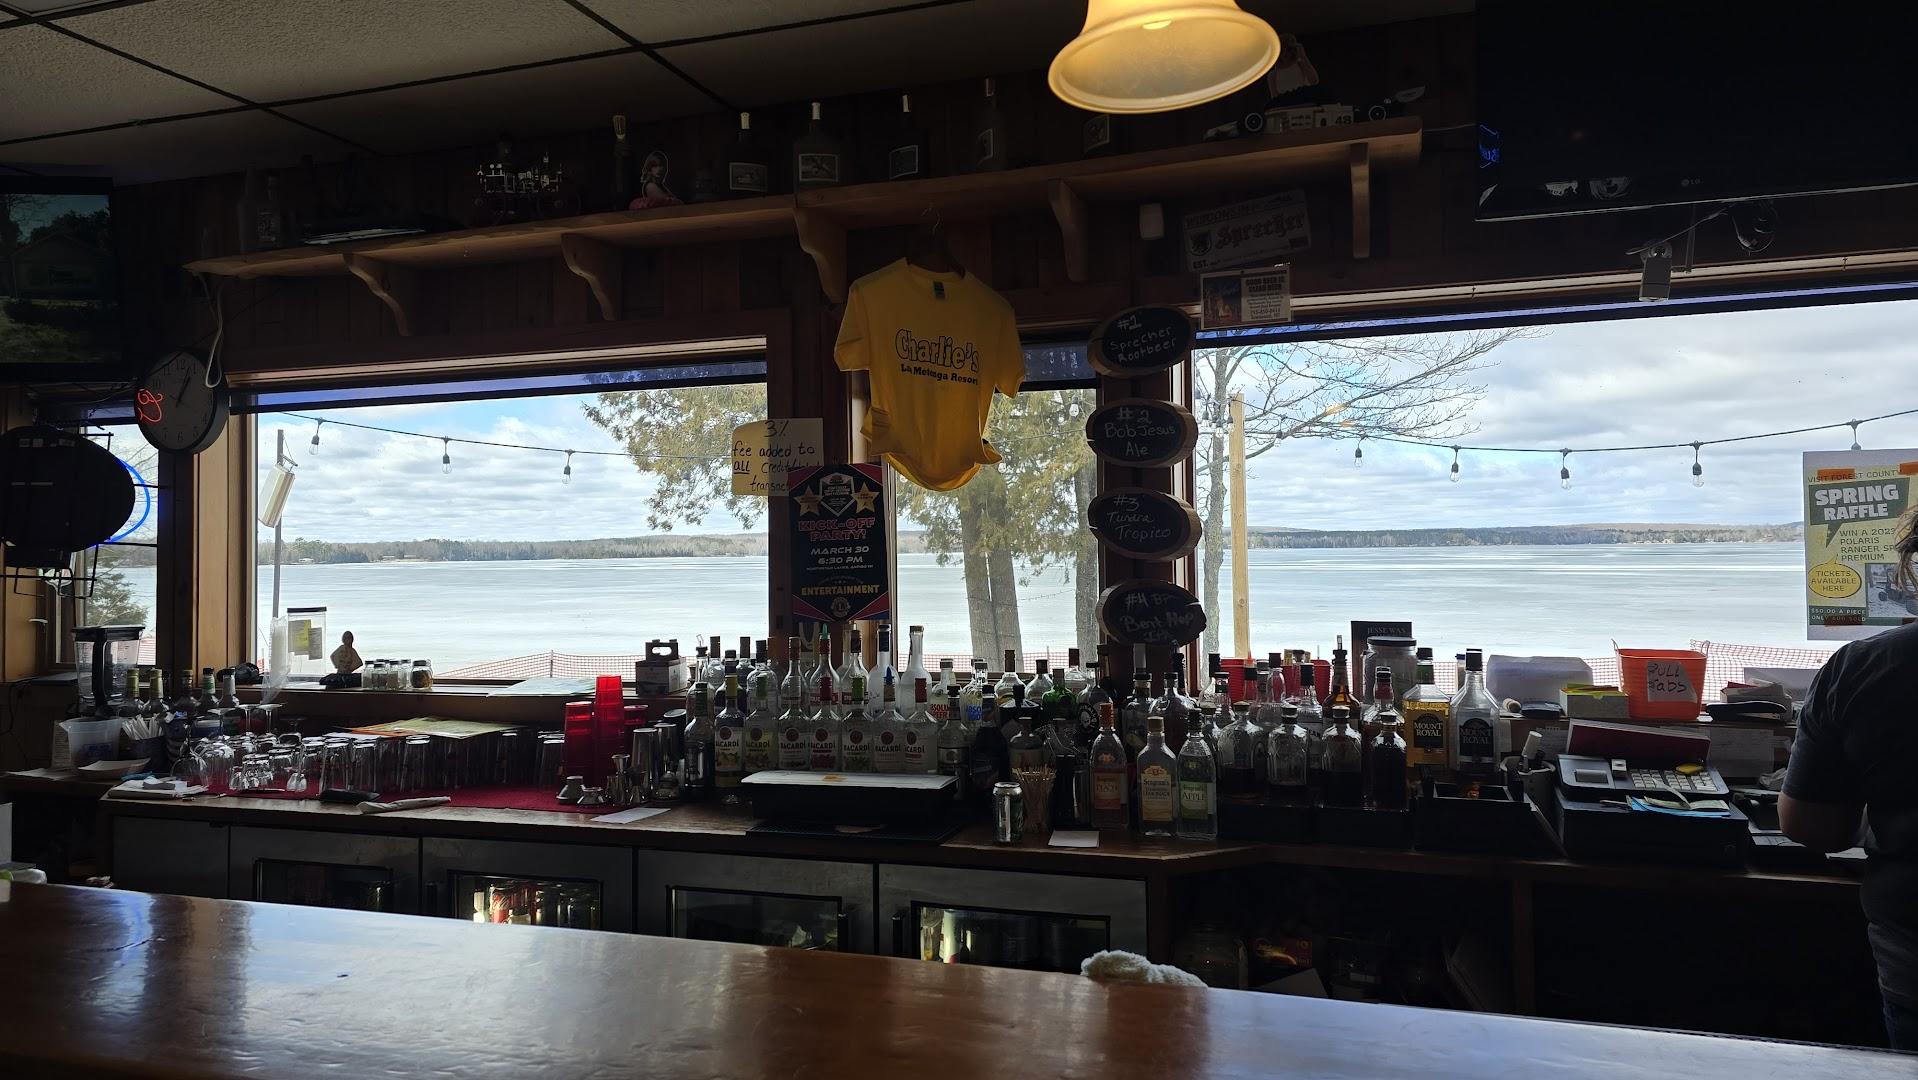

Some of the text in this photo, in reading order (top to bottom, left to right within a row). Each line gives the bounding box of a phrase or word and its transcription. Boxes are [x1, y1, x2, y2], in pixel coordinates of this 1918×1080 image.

[895, 328, 979, 373] Charlie's
[764, 420, 789, 437] 3%
[733, 440, 815, 458] fee added to
[1125, 441, 1150, 457] Ale
[1830, 472, 1864, 481] FOREST
[1815, 484, 1899, 506] SPRING
[1113, 495, 1140, 511] #3
[1824, 503, 1888, 521] RAFFLE
[798, 517, 876, 532] KICK-OFF
[809, 529, 867, 541] PARTY!
[1840, 530, 1858, 538] WIN
[1840, 537, 1879, 545] POLARIS
[810, 545, 870, 556] MARCH 30
[1841, 545, 1880, 553] RANGER
[818, 556, 863, 565] 6:30 PM
[1841, 553, 1884, 561] PREMIUM
[801, 584, 881, 596] ENTERTAINMENT
[1414, 722, 1441, 730] MOUNT
[1416, 729, 1441, 737] ROYAL
[1463, 736, 1488, 744] ROYAL
